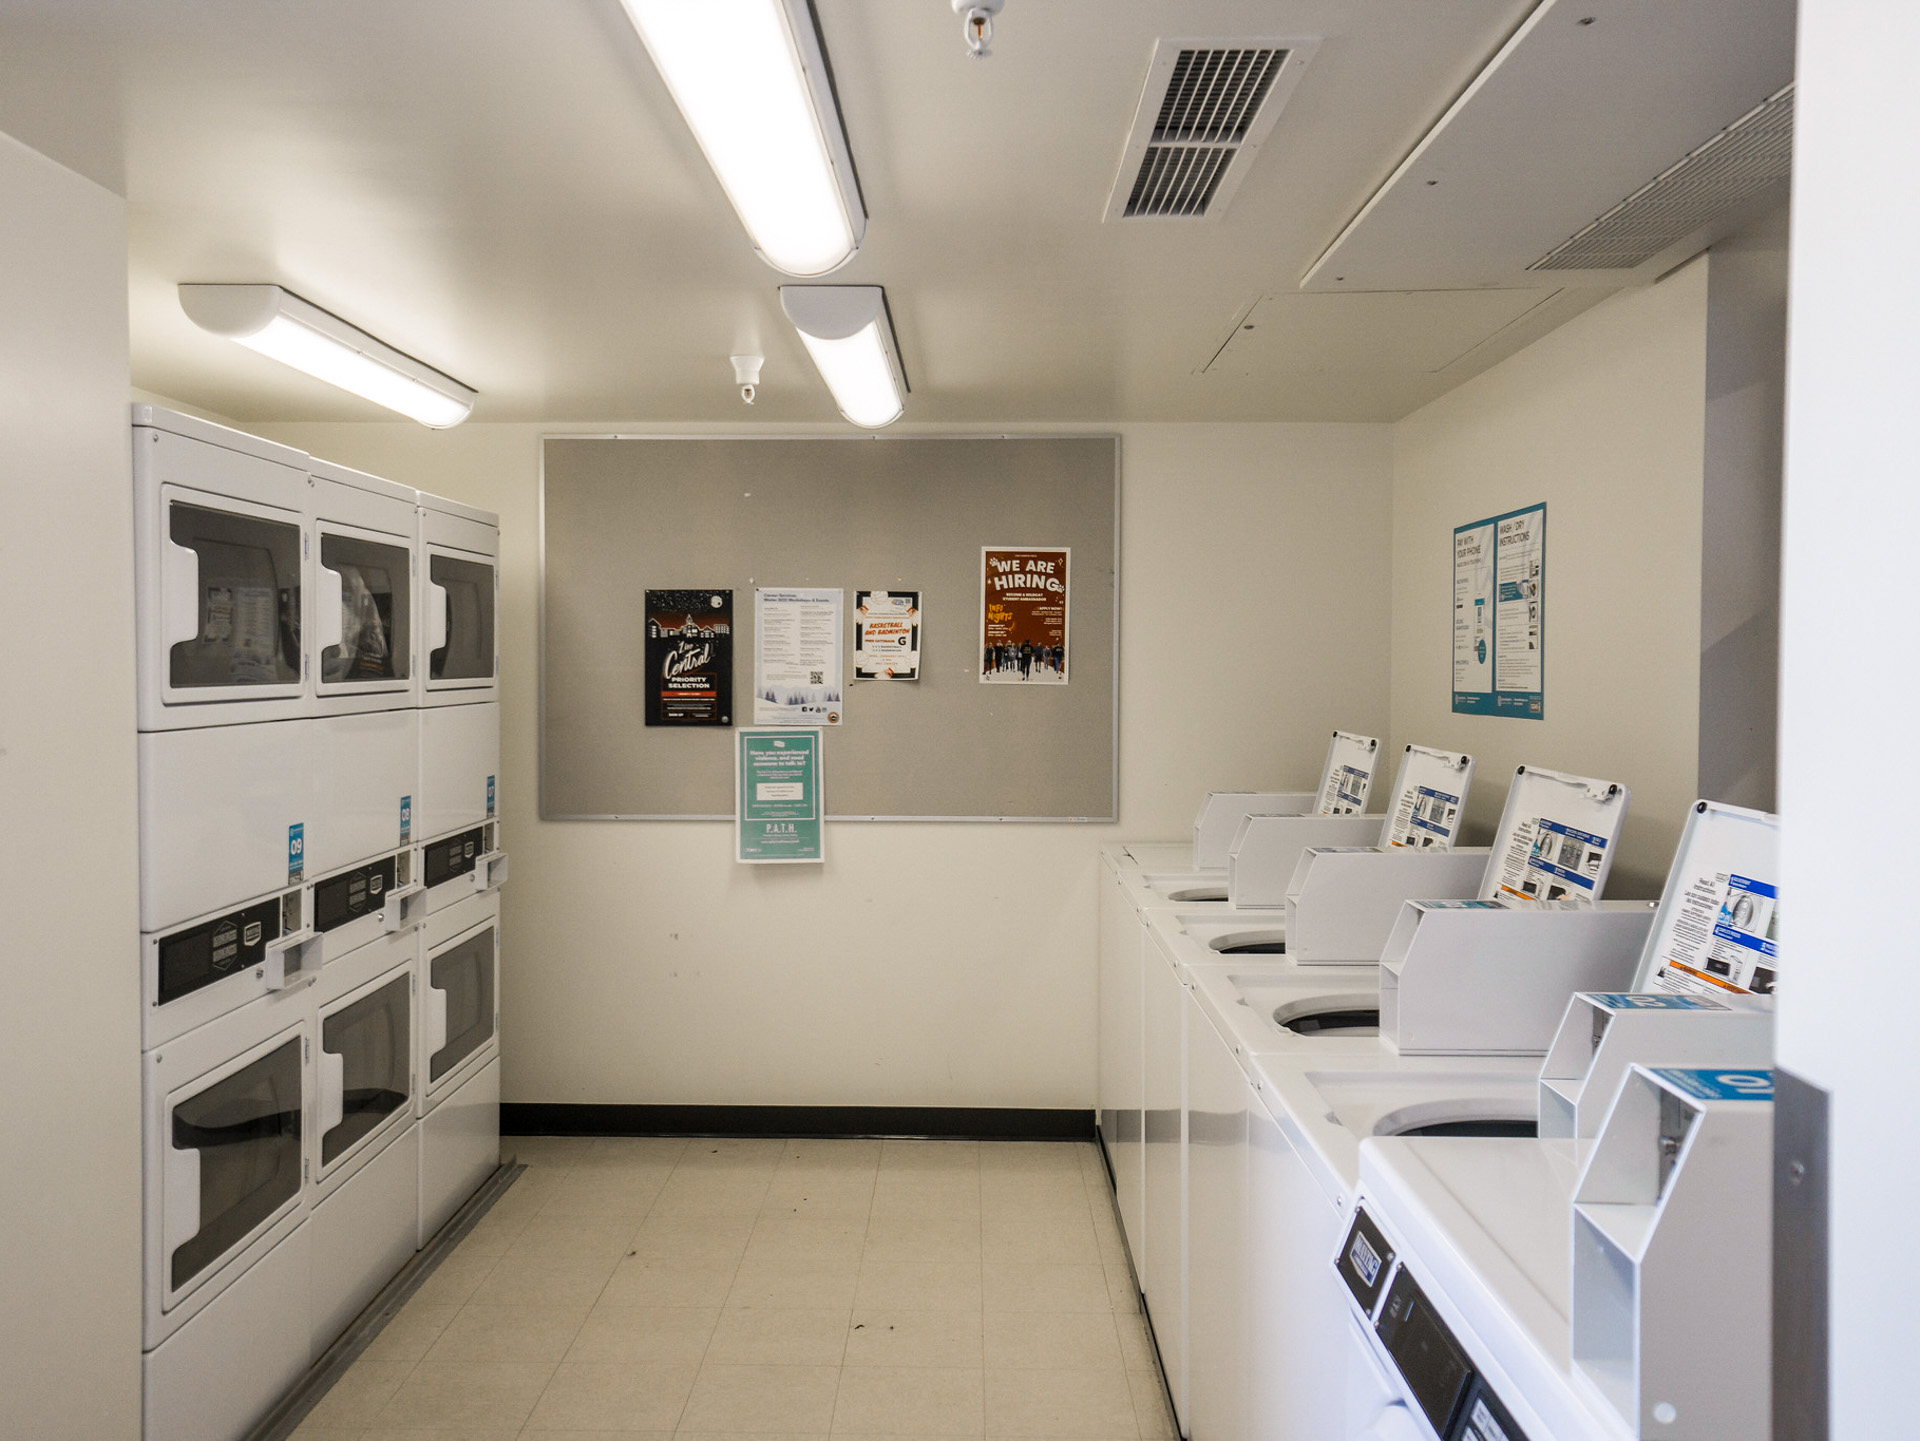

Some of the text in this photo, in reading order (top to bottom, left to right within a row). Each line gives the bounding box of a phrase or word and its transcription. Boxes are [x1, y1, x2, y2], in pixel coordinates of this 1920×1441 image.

[1500, 531, 1530, 546] INSTRUCTIONS
[1467, 545, 1481, 556] PHONE
[996, 560, 1056, 574] WE ARE
[994, 574, 1060, 592] HIRING
[898, 636, 906, 646] G
[665, 643, 711, 679] Central
[766, 824, 798, 833] P.A.T.H.
[291, 838, 302, 855] 09
